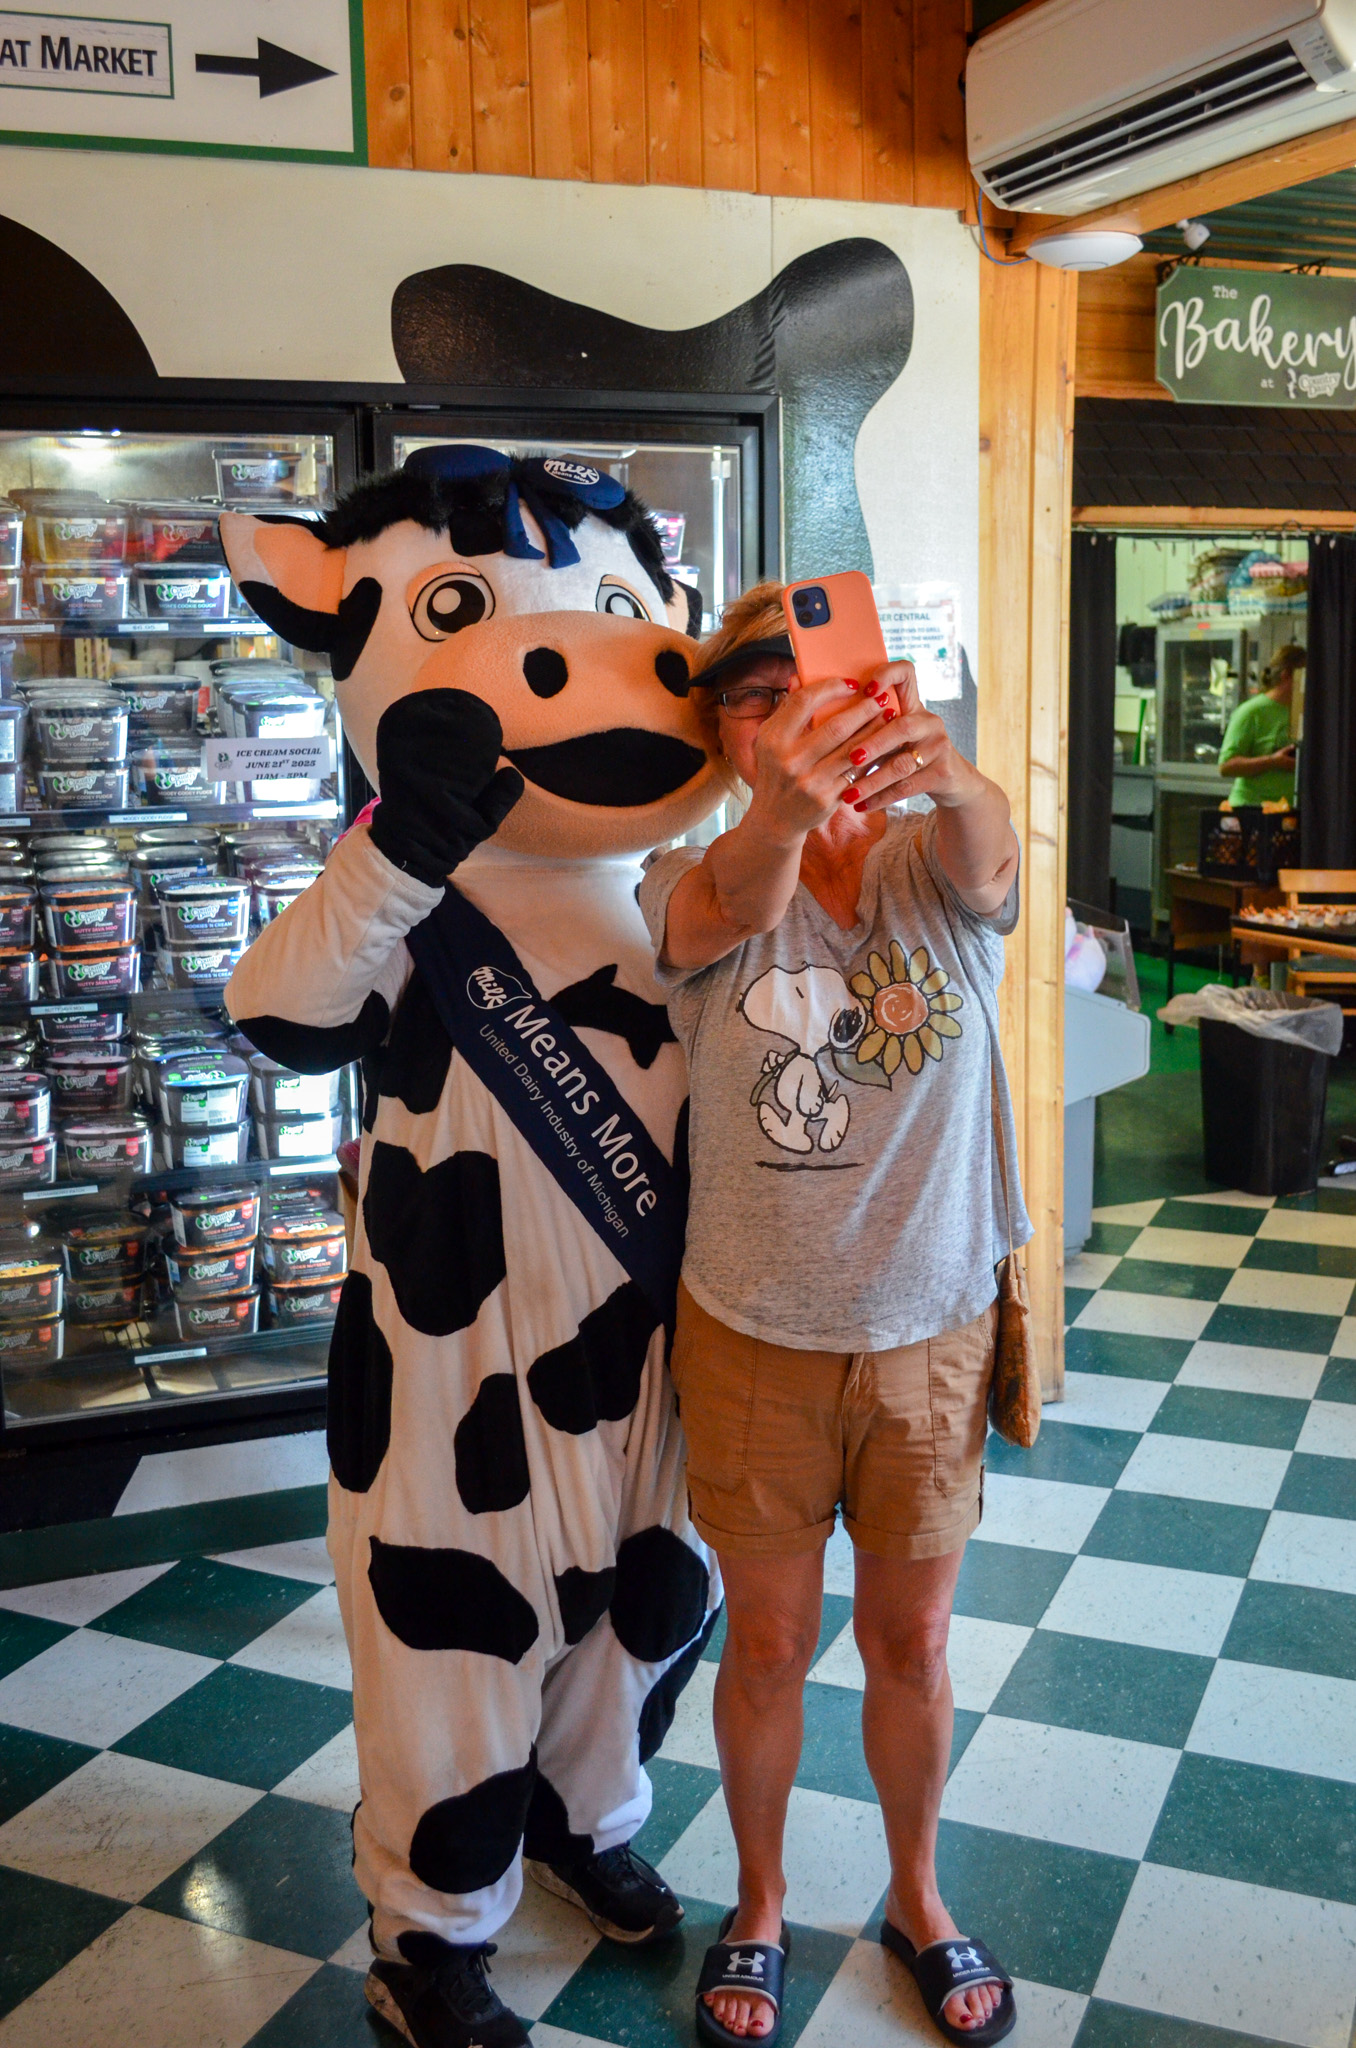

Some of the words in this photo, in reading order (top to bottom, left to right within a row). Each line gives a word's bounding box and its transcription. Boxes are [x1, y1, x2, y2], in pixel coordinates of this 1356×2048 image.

[40, 34, 158, 77] MARKET
[1212, 284, 1238, 300] The
[1159, 293, 1356, 391] Bakery
[1260, 378, 1275, 389] at
[894, 612, 931, 622] CENTRAL
[253, 748, 287, 757] CREAM
[288, 747, 322, 756] SOCIAL
[245, 761, 271, 769] JUNE
[291, 759, 316, 768] 2025
[471, 965, 507, 1010] milk
[503, 1003, 601, 1116] Means
[590, 1112, 658, 1218] More
[478, 1022, 520, 1066] United
[513, 1062, 546, 1102] Dairy
[539, 1100, 581, 1159] Industry
[576, 1158, 594, 1176] of
[586, 1171, 631, 1240] Michigan
[740, 1974, 764, 1983] ARMOUR
[952, 1969, 971, 1978] UNDER
